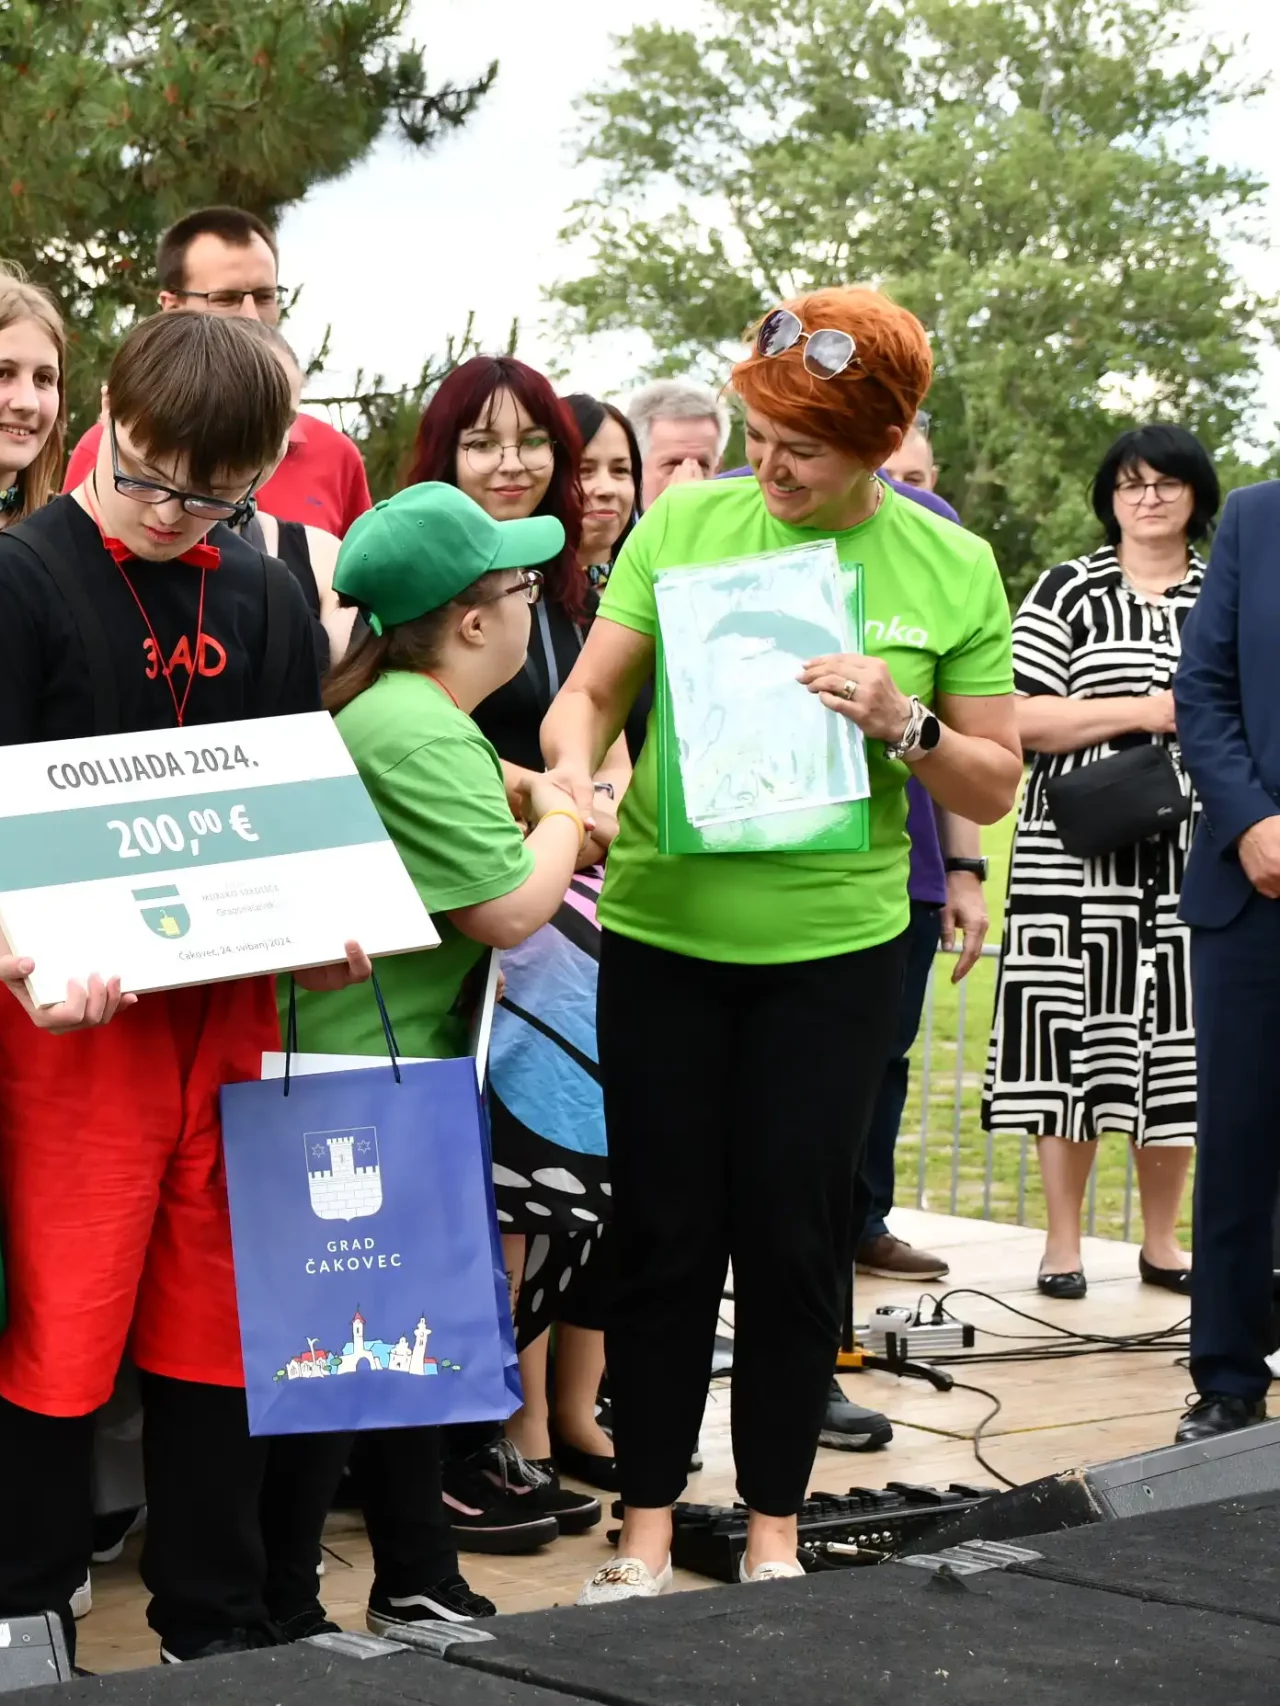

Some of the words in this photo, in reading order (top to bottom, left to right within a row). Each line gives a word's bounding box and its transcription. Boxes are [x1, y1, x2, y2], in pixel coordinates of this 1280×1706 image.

[47, 751, 186, 790] COOLIJADA
[184, 744, 260, 775] 2024.
[228, 804, 260, 842] €
[326, 1237, 375, 1253] GRAD
[305, 1253, 402, 1274] ČAKOVEC
